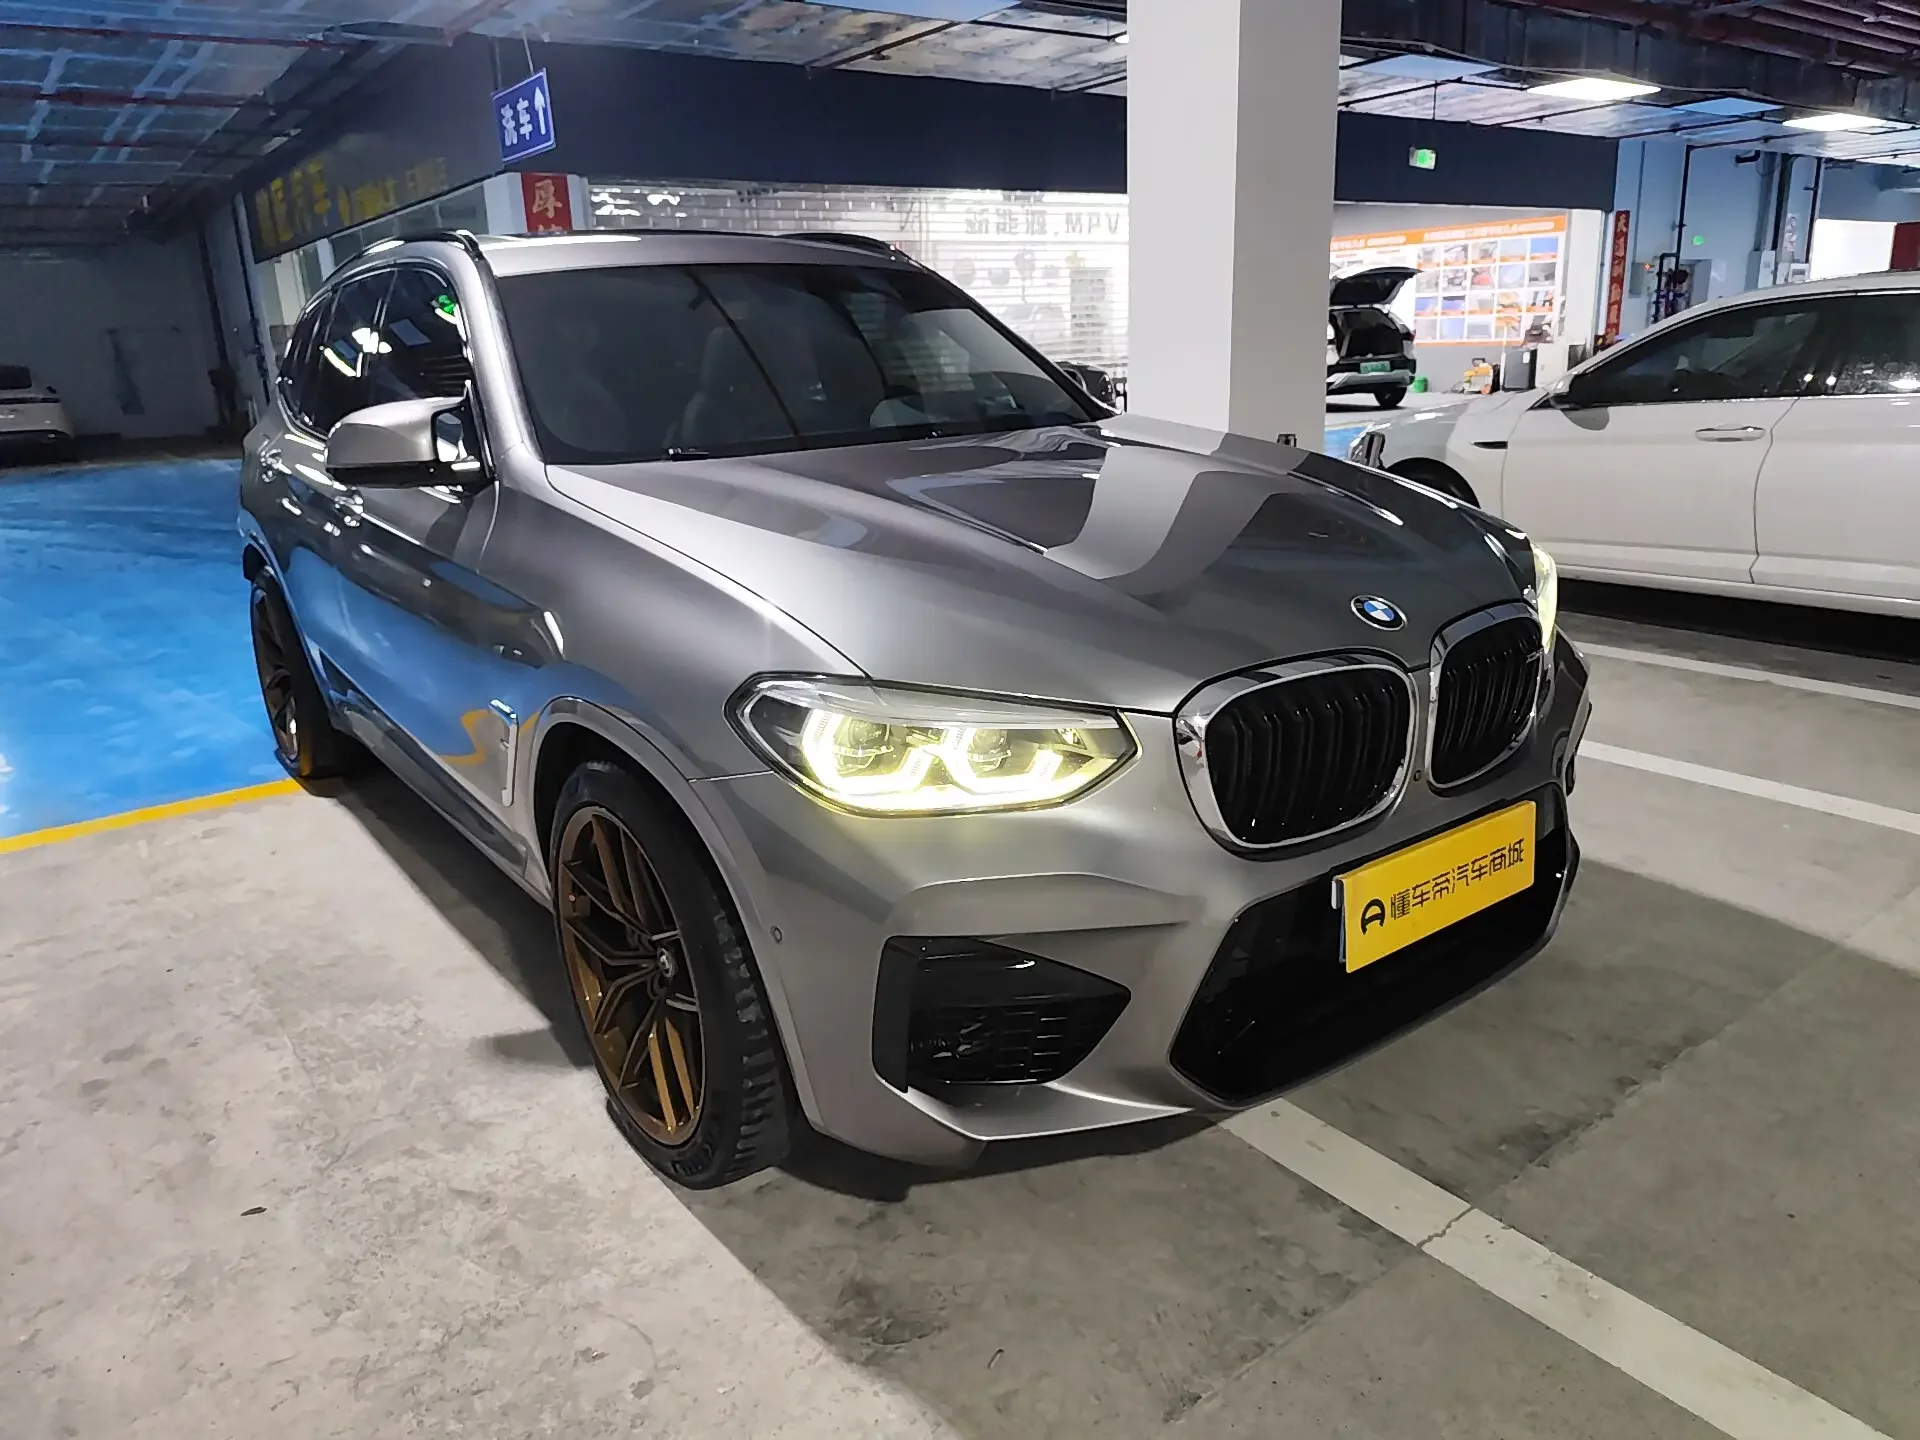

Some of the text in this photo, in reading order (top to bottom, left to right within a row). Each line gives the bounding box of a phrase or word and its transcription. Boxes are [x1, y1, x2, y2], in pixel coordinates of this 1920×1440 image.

[532, 179, 563, 232] 厚
[1389, 837, 1525, 921] 懂车帝汽车商城
